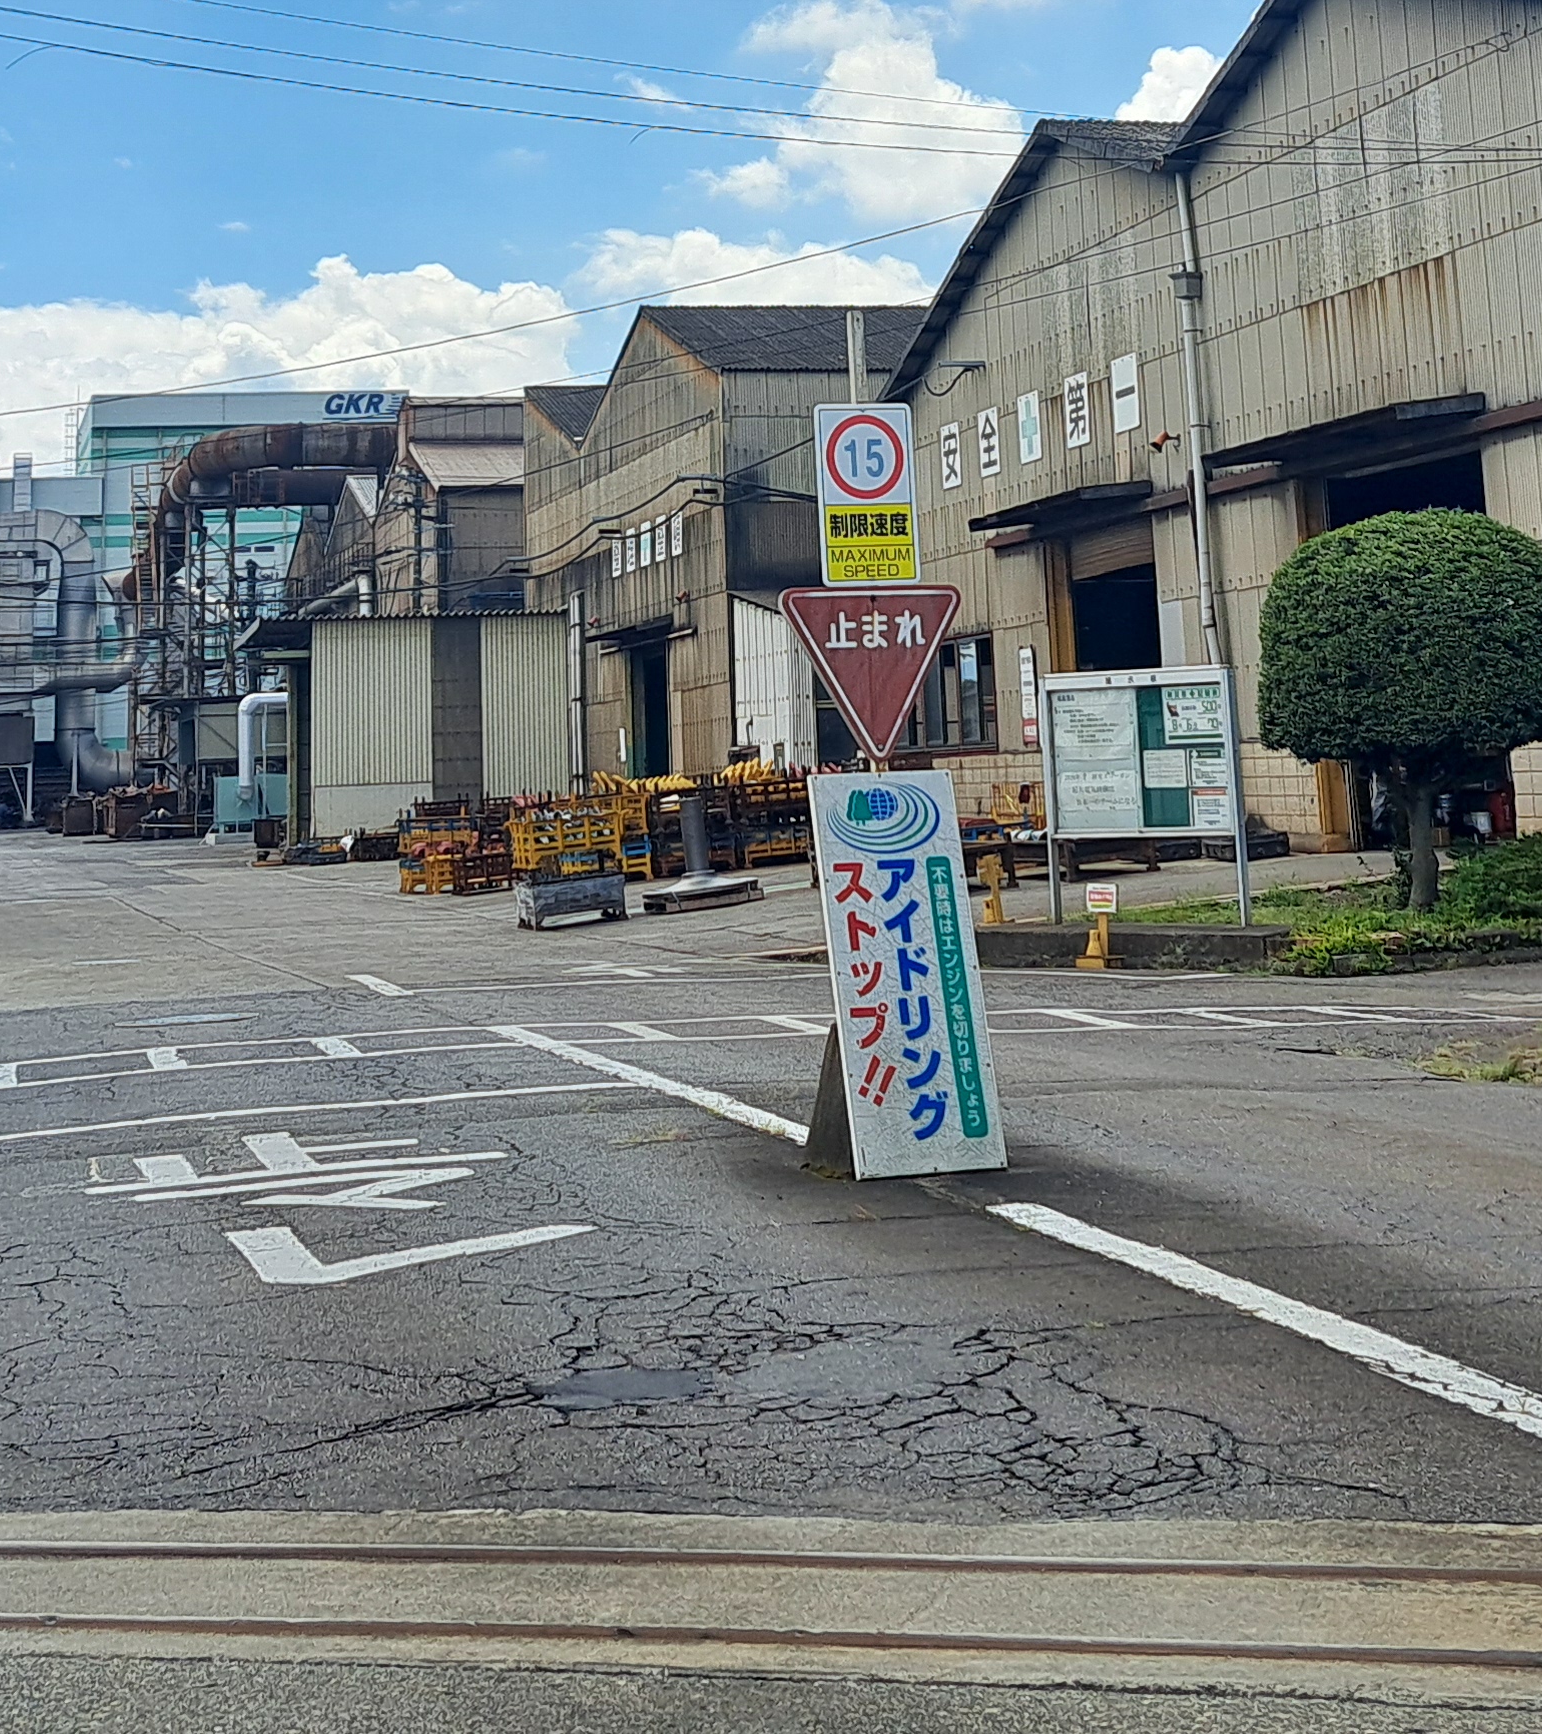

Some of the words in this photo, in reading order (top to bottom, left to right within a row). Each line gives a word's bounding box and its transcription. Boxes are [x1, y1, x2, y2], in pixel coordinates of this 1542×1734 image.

[324, 393, 384, 415] GKR
[843, 438, 885, 478] 15
[829, 511, 909, 539] 制限速度
[830, 547, 911, 563] MAXIMUM
[843, 563, 900, 578] SPEED
[824, 608, 926, 649] 止まれ
[876, 858, 949, 1141] アイドリング
[930, 866, 981, 1128] 不要時はエンジンを切りましょう
